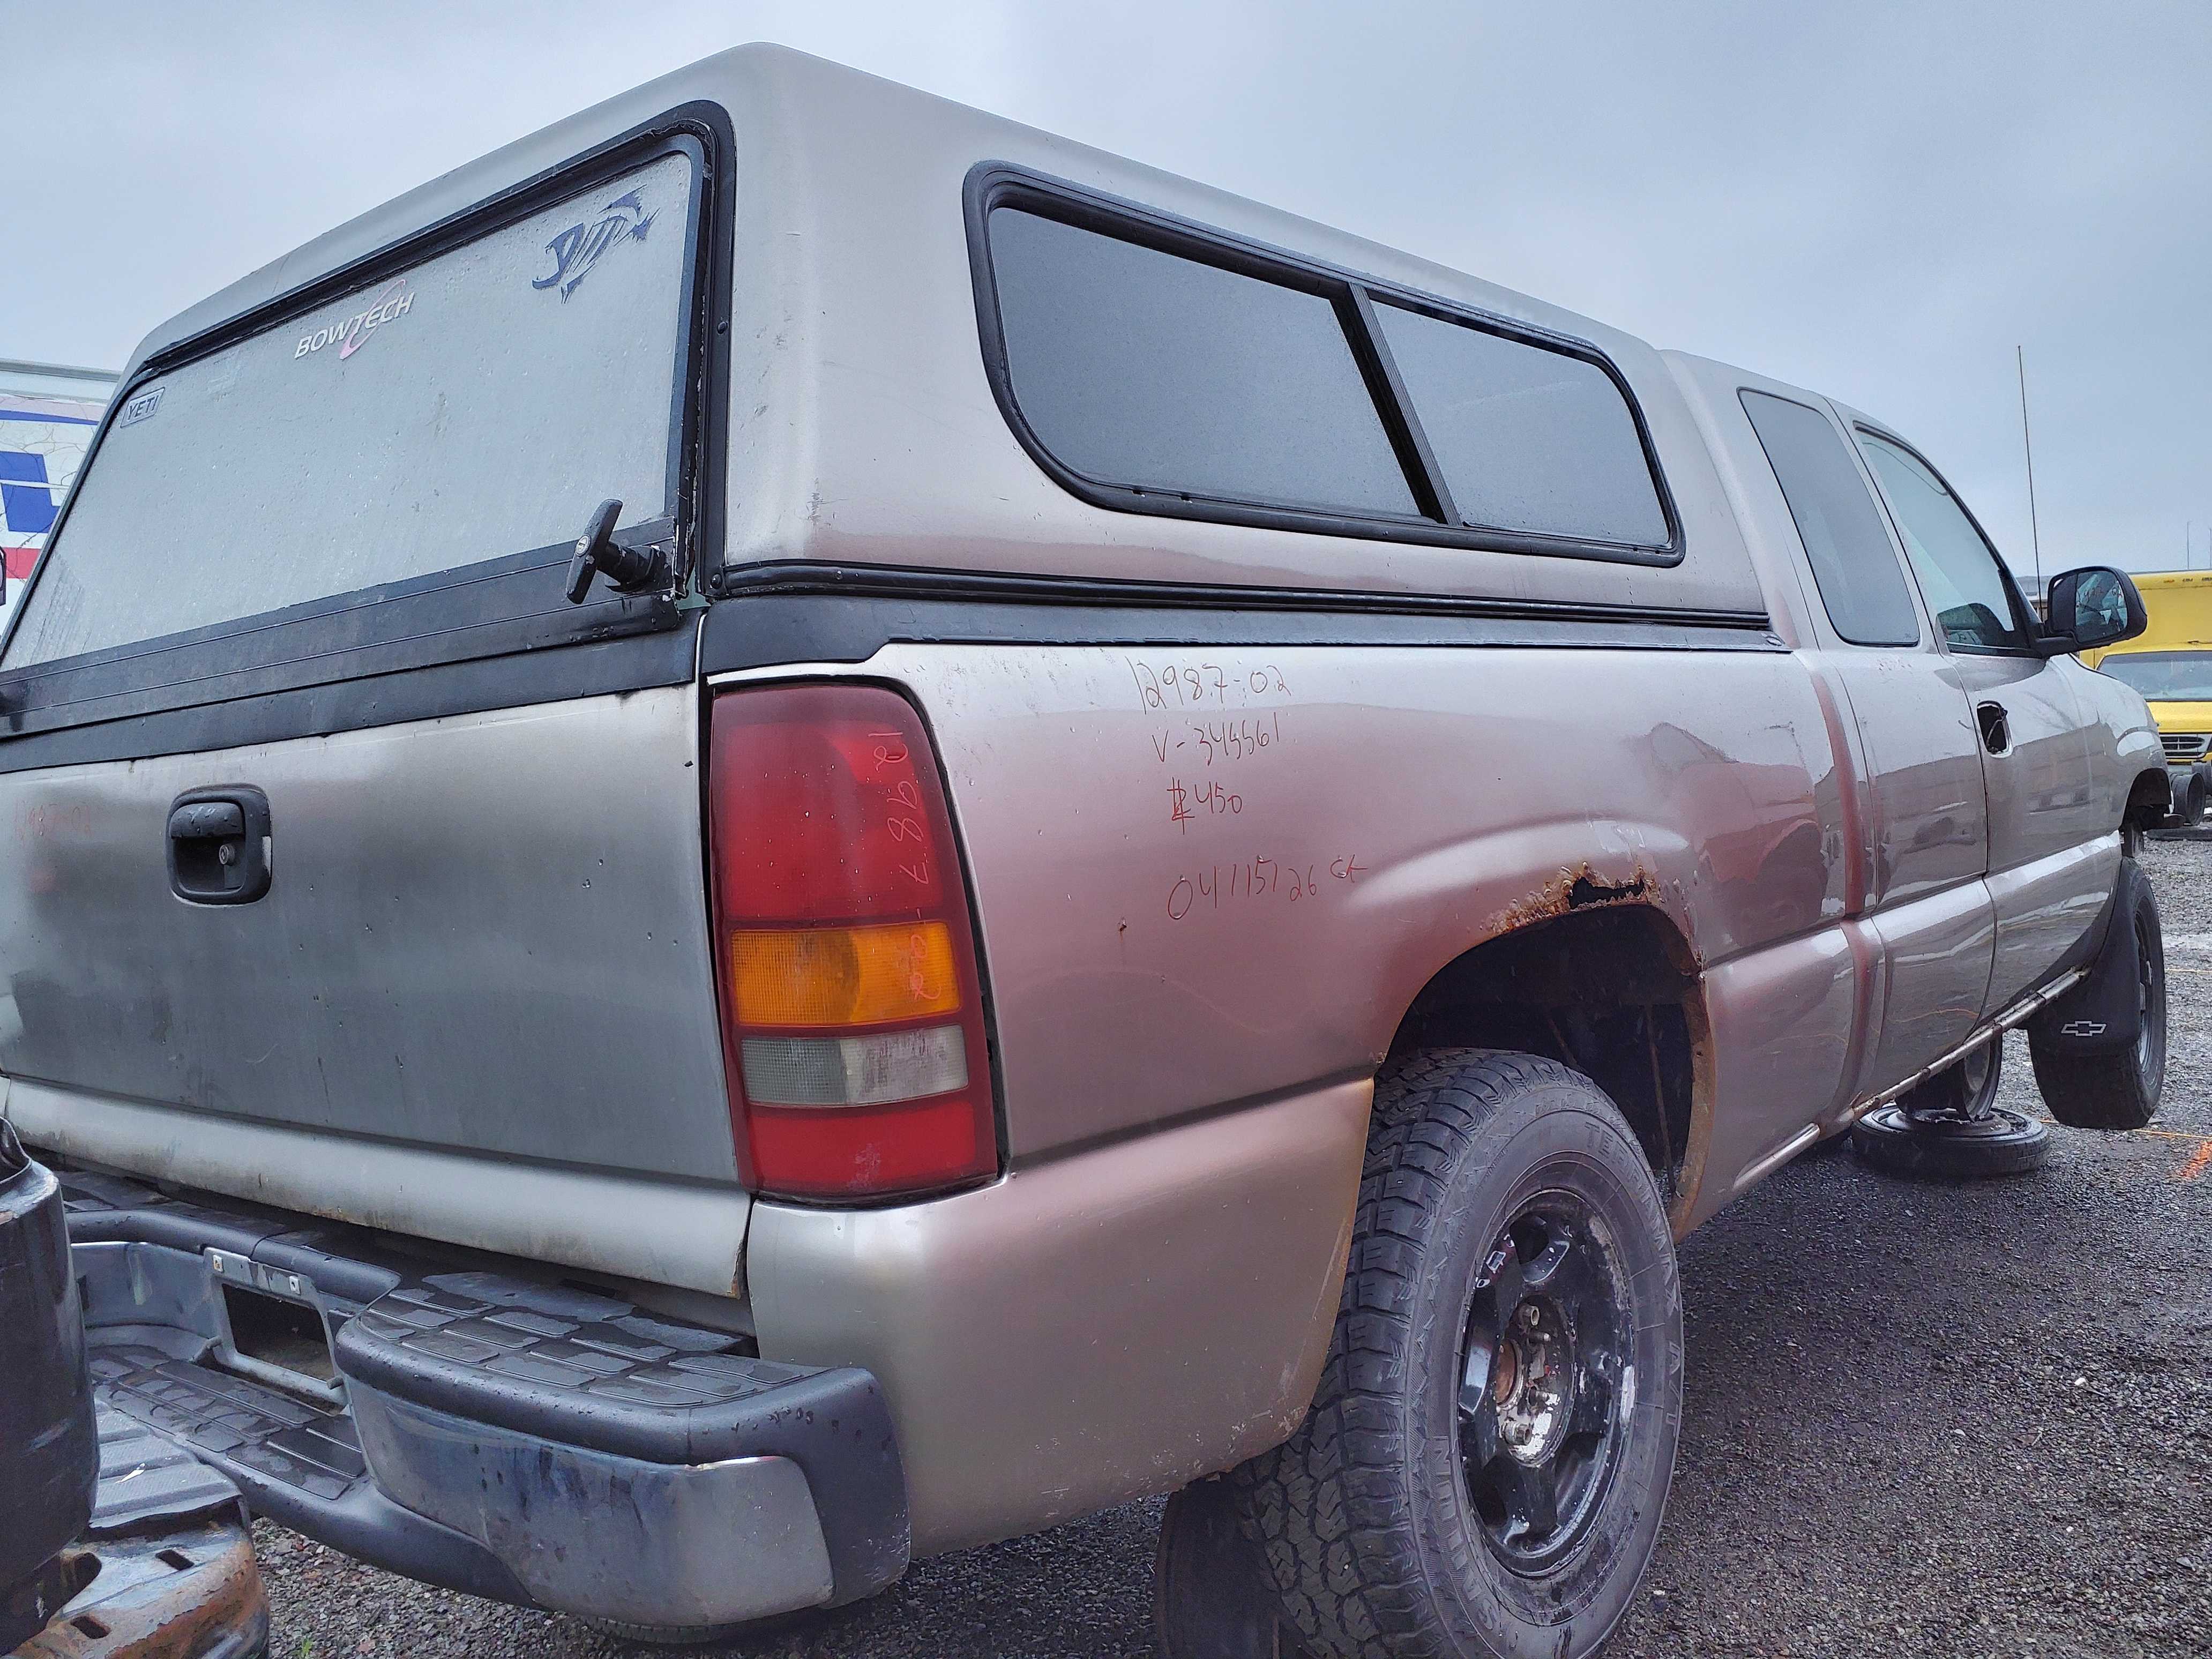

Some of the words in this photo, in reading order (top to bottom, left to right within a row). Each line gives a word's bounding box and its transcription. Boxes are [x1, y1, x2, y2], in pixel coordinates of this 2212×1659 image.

[294, 292, 415, 359] BOWTECH
[128, 395, 160, 420] YETI
[1124, 655, 1292, 715] 12987-02
